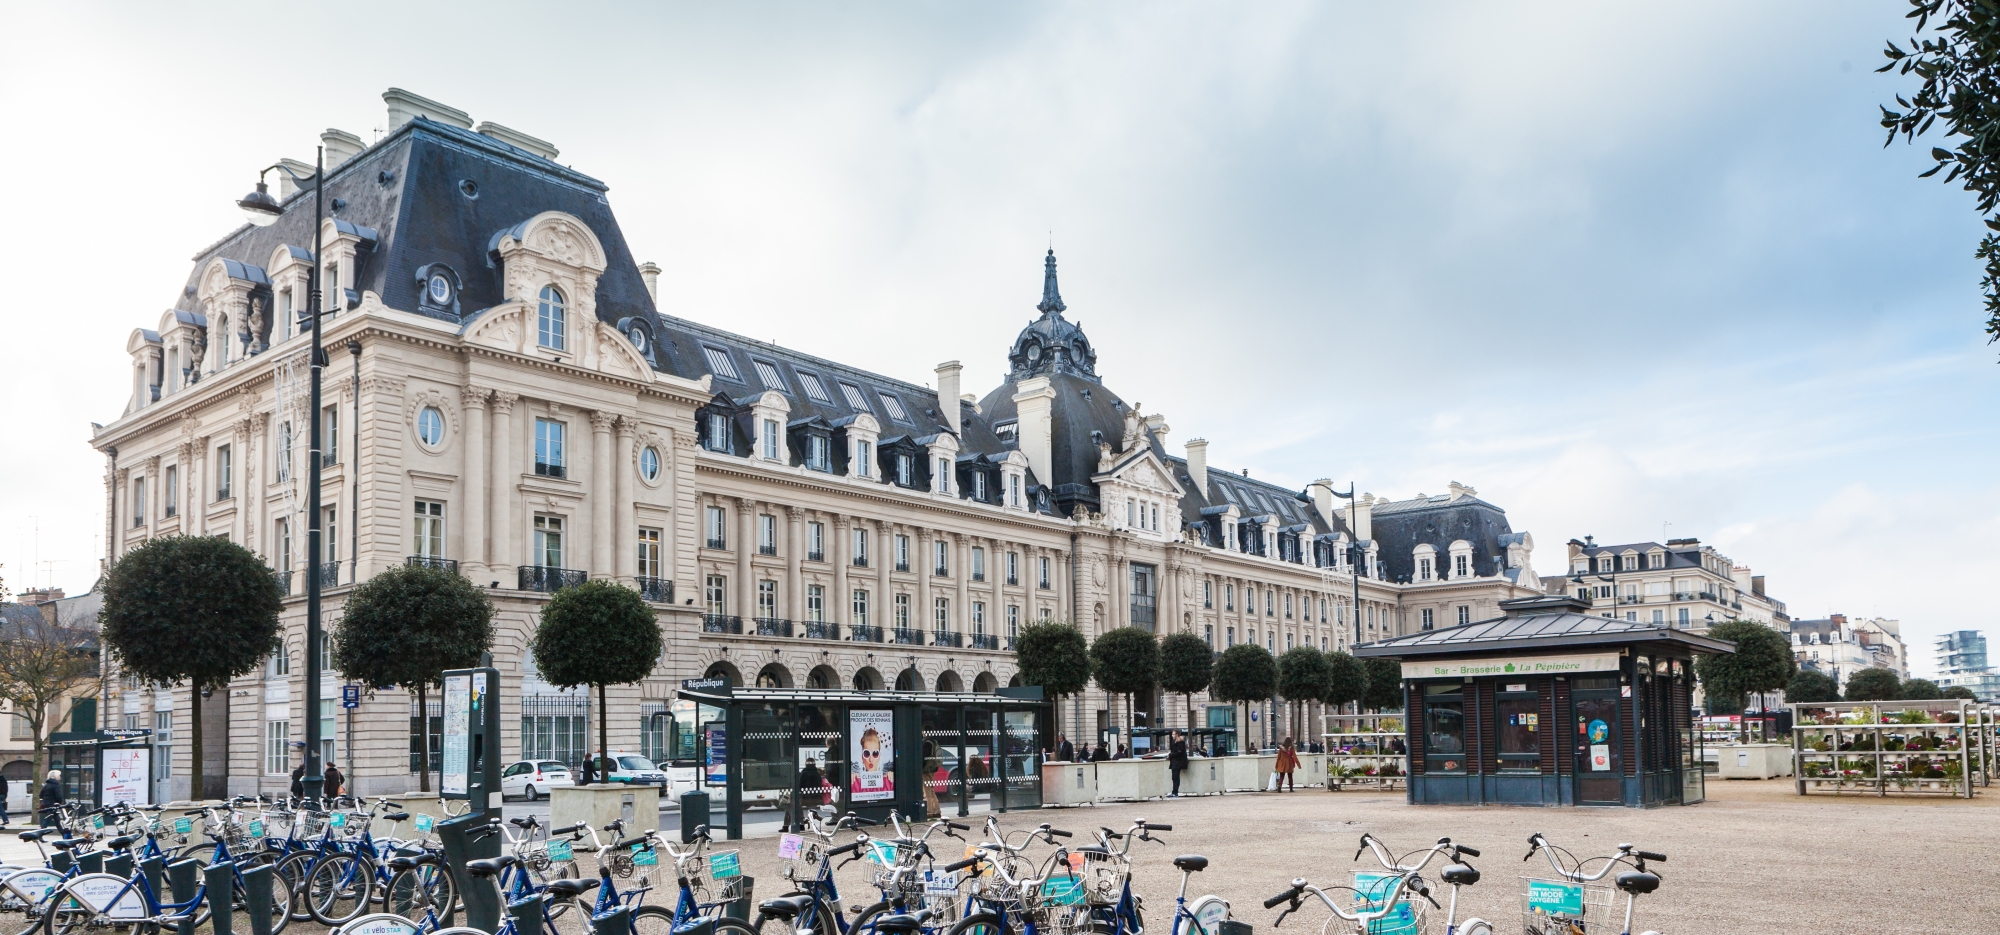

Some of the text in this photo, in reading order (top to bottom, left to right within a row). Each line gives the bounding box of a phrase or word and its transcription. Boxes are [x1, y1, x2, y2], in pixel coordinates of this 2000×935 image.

[1435, 667, 1449, 675] Bar
[1460, 665, 1501, 674] Brasserie
[1519, 663, 1531, 672] La
[1535, 662, 1580, 672] Pépinière
[687, 678, 724, 688] République
